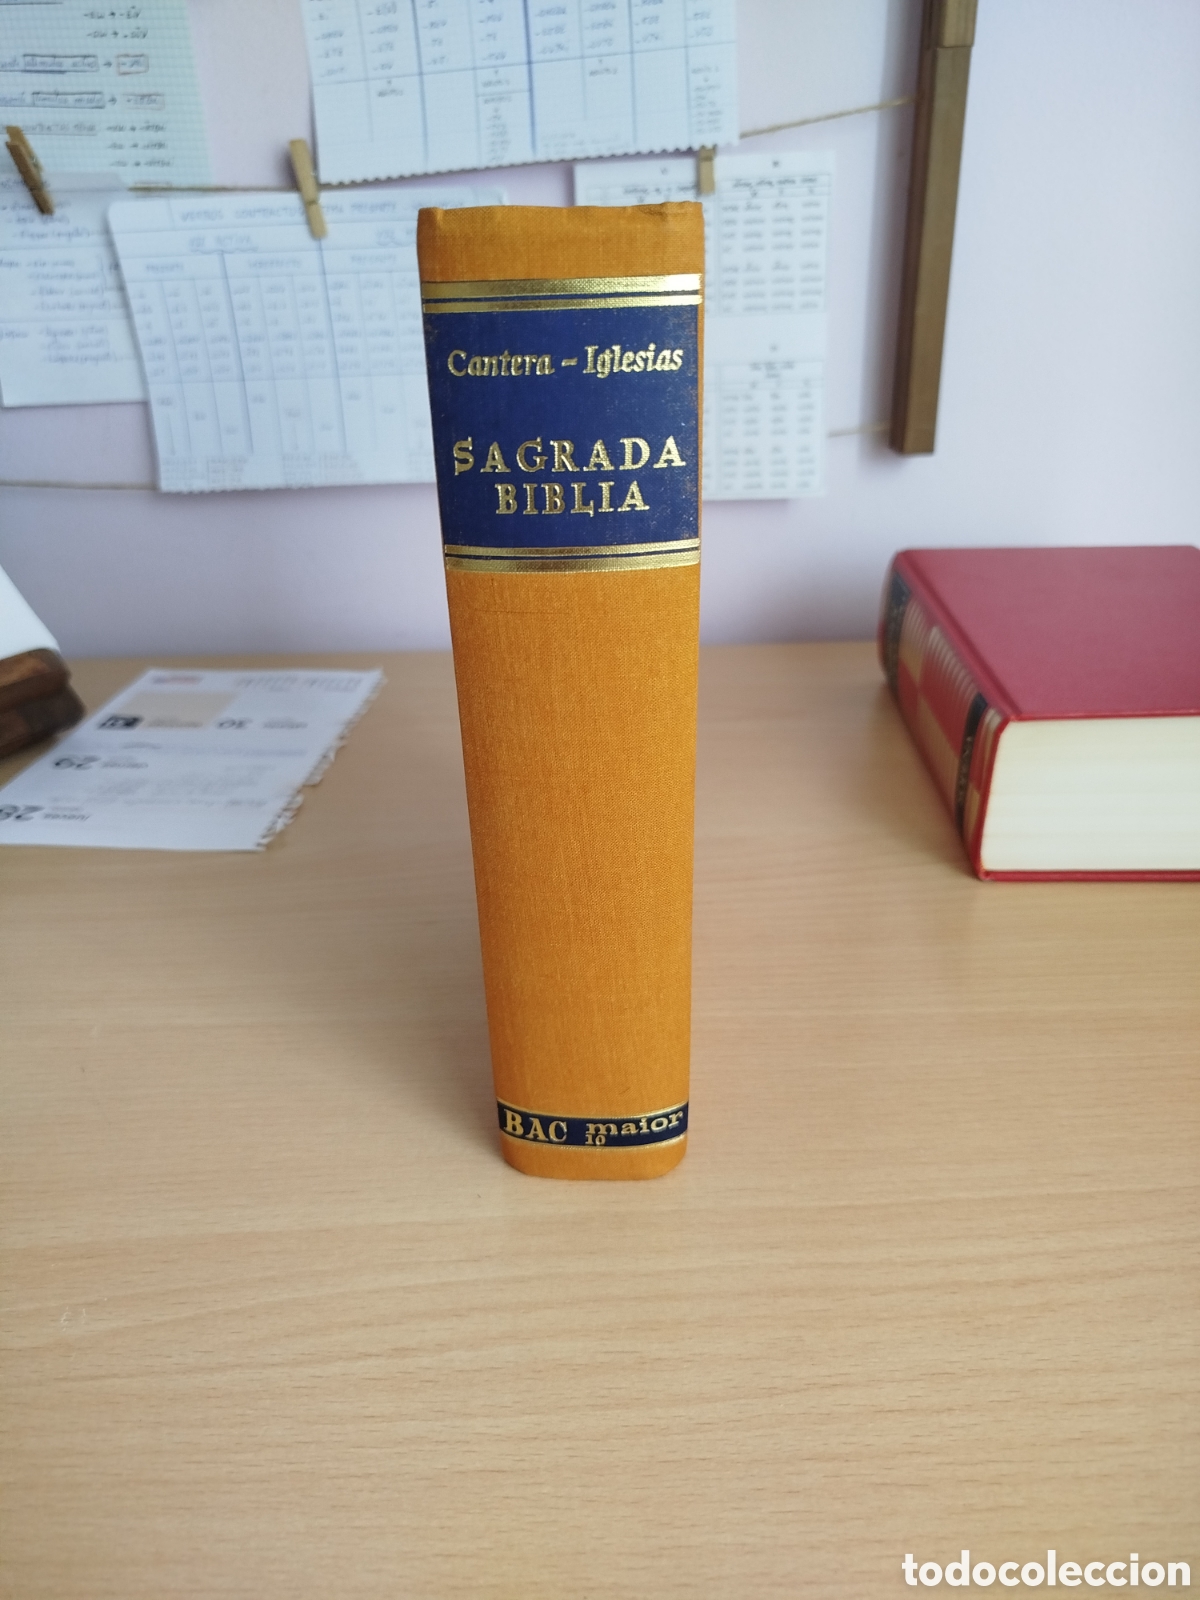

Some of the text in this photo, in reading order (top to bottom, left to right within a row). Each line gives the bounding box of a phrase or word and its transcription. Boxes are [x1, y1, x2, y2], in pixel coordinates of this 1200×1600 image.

[447, 349, 555, 377] Cantera
[583, 342, 684, 378] Iglesias
[453, 435, 687, 476] SAGRADA
[494, 480, 650, 517] BIBLIA
[504, 1109, 683, 1143] BAC maior
